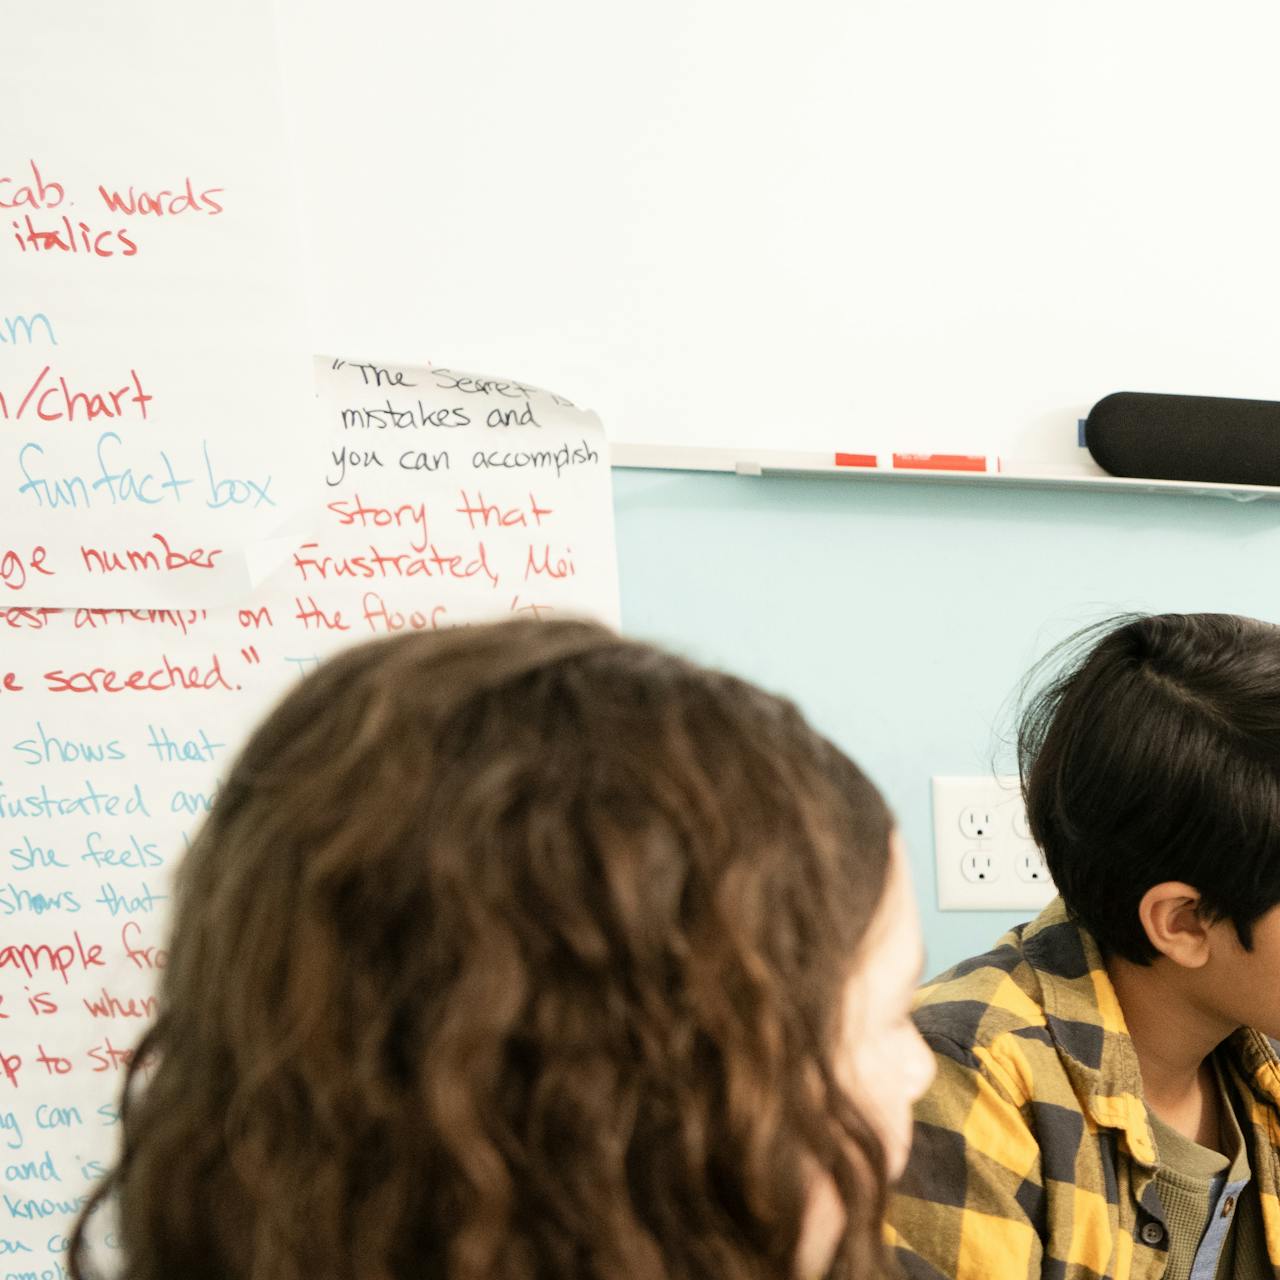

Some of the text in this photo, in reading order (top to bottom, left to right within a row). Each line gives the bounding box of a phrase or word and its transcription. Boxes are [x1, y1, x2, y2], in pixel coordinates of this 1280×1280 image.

[12, 213, 138, 258] italics
[0, 312, 59, 346] m
[341, 400, 542, 430] mistakes and
[18, 431, 277, 510] fun fact box
[325, 440, 599, 487] you can accomplish
[456, 489, 553, 530] that
[79, 532, 224, 575] number
[524, 543, 576, 582] Mei
[0, 606, 64, 629] est
[238, 606, 274, 629] on
[295, 595, 351, 631] the
[13, 720, 227, 766] shows that
[9, 835, 70, 871] she
[80, 831, 165, 869] feels
[95, 881, 170, 917] that
[24, 985, 58, 1016] is
[36, 1044, 72, 1076] to
[35, 1103, 83, 1129] can
[5, 1150, 62, 1182] and
